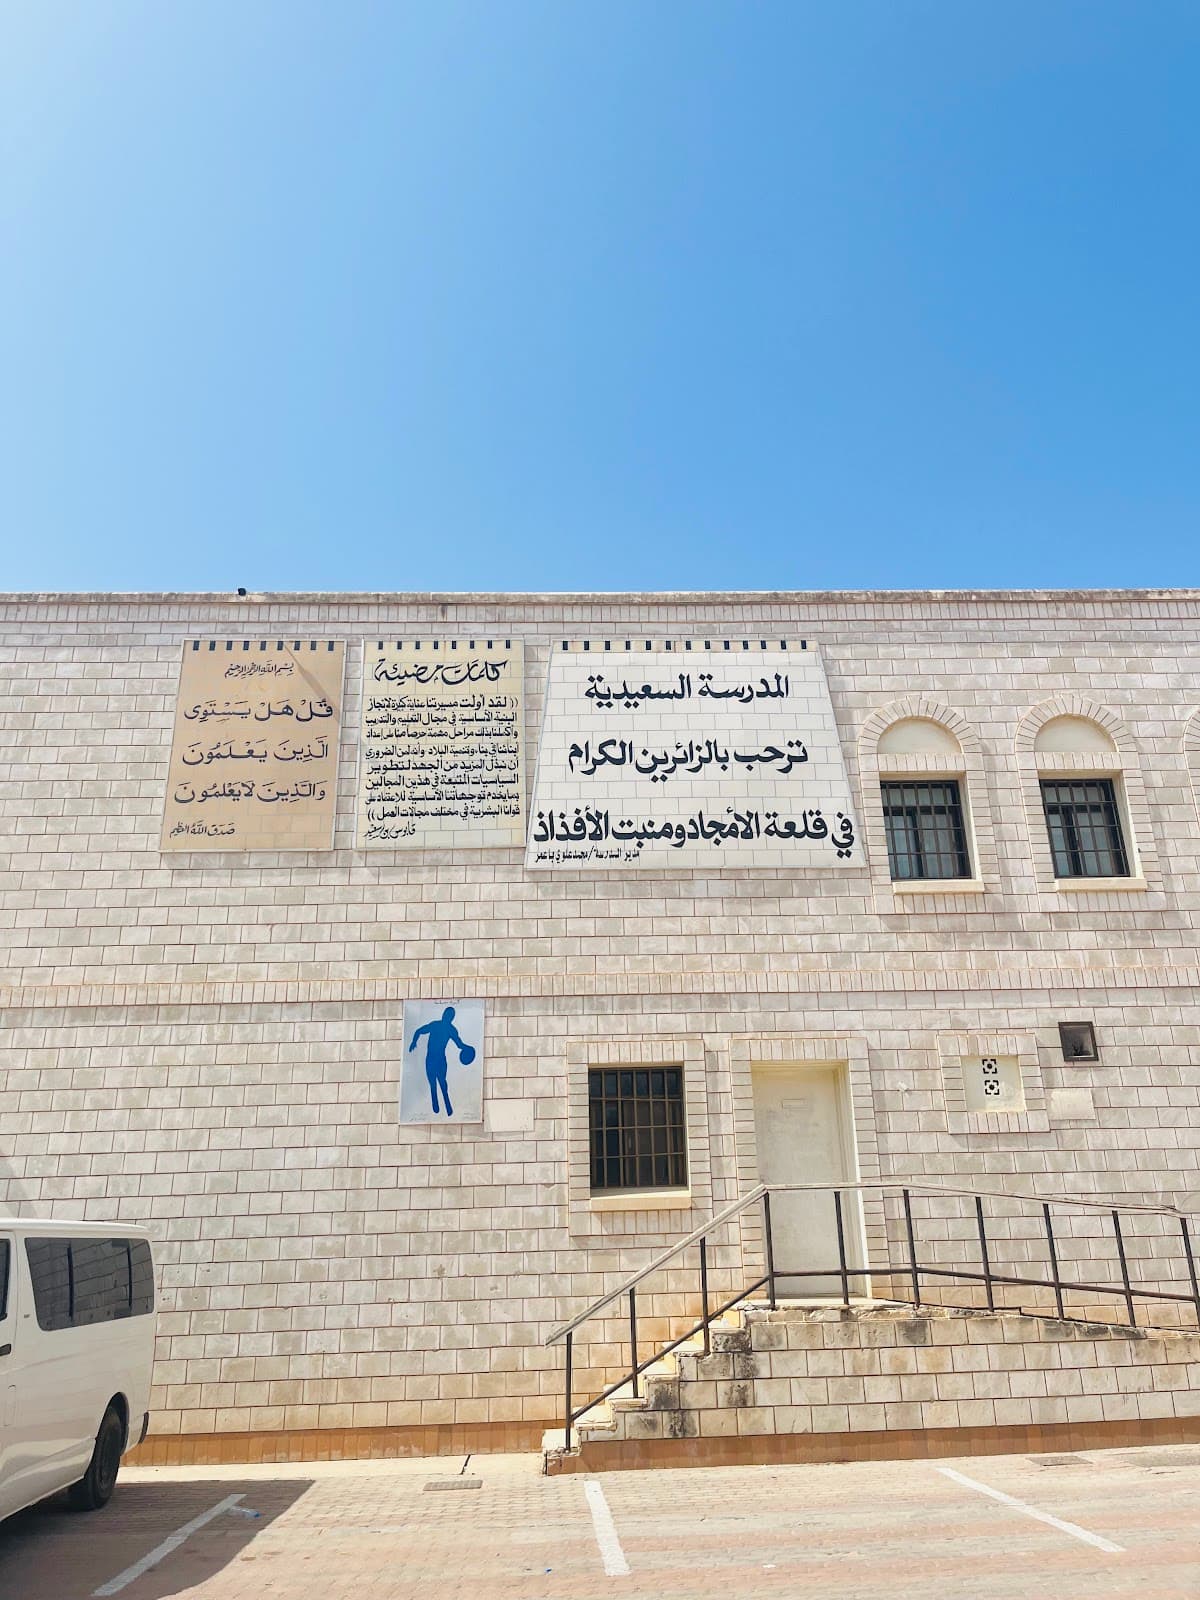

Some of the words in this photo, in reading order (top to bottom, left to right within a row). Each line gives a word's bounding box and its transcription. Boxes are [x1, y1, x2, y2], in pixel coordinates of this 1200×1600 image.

[584, 673, 692, 709] السعيدية
[697, 673, 789, 703] المدرسة
[408, 699, 426, 711] عناية
[427, 697, 458, 711] مسيرتنا
[460, 694, 485, 711] أولت
[489, 695, 507, 708] لقد
[365, 713, 396, 726] والتدريب
[397, 712, 421, 724] التعليم
[422, 712, 447, 725] مجال
[449, 711, 456, 727] في
[458, 710, 493, 724] الأساسية
[494, 711, 517, 725] البنية
[395, 728, 407, 738] منا
[449, 727, 474, 739] مراحل
[475, 727, 492, 738] بذلك
[365, 745, 396, 759] الضروري
[428, 744, 449, 757] البلاد
[449, 744, 475, 757] وتنمية
[568, 738, 633, 776] الكرام
[733, 738, 809, 774] ترحب
[366, 759, 411, 775] لتطوير
[411, 759, 443, 773] الجهد
[443, 762, 458, 771] من
[459, 759, 485, 772] المزيد
[486, 758, 506, 772] نبذل
[507, 757, 519, 770] أن
[635, 738, 730, 783] بالزائرين
[365, 775, 404, 790] المجالين
[405, 774, 430, 789] هذين
[431, 772, 439, 790] في
[440, 773, 470, 788] المتبعة
[377, 791, 405, 803] للاعتماد
[407, 789, 444, 804] الأساسية
[445, 790, 486, 803] توجهاتنا
[486, 792, 506, 802] يخدم
[506, 789, 519, 802] بما
[377, 806, 400, 821] العمل
[400, 806, 430, 819] مجالات
[430, 806, 459, 817] مختلف
[459, 802, 468, 820] في
[470, 804, 502, 819] البشرية
[503, 804, 520, 818] قوانا
[389, 821, 416, 839] قابوس
[533, 806, 609, 843] الأفذاذ
[687, 806, 760, 846] الأمجاد
[764, 809, 829, 841] قلعة
[362, 824, 382, 840] سعيد
[611, 816, 687, 850] ومنبت
[831, 807, 855, 859] في
[624, 849, 639, 861] مدير
